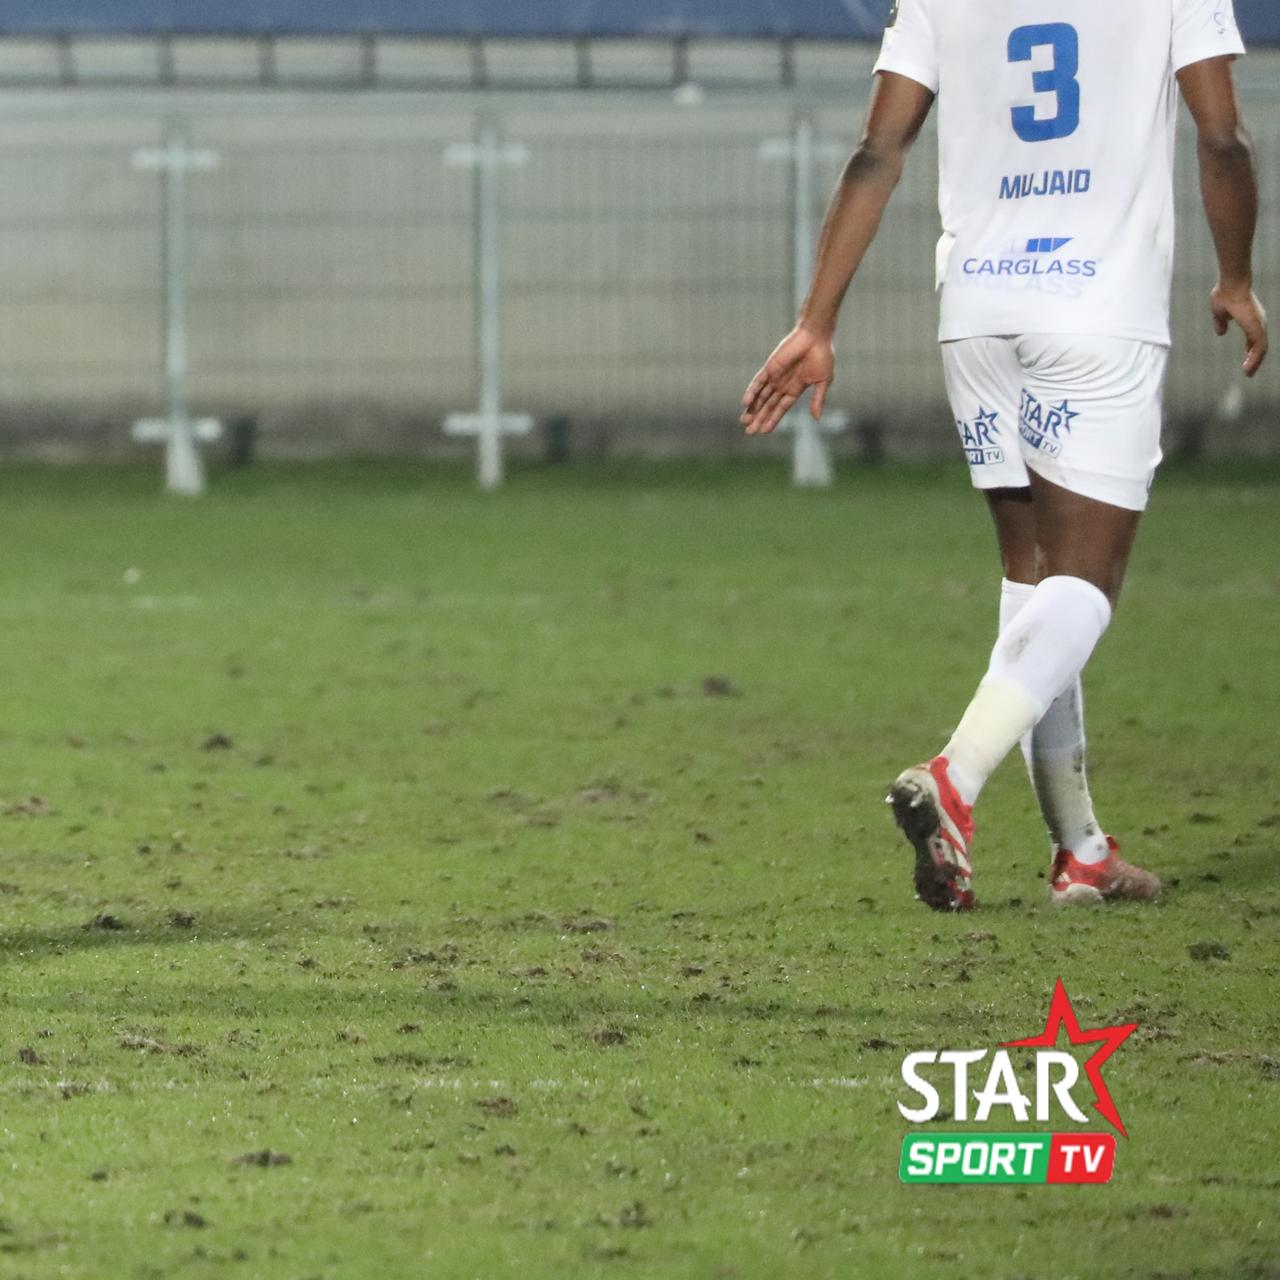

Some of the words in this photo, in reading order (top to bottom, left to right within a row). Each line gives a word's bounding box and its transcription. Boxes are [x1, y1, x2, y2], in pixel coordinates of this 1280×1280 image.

[1007, 22, 1080, 143] 3
[998, 169, 1091, 199] MUJAID
[962, 258, 1097, 277] CARGLASS
[957, 421, 996, 446] AR
[986, 451, 1000, 461] TV
[1044, 442, 1058, 453] TV
